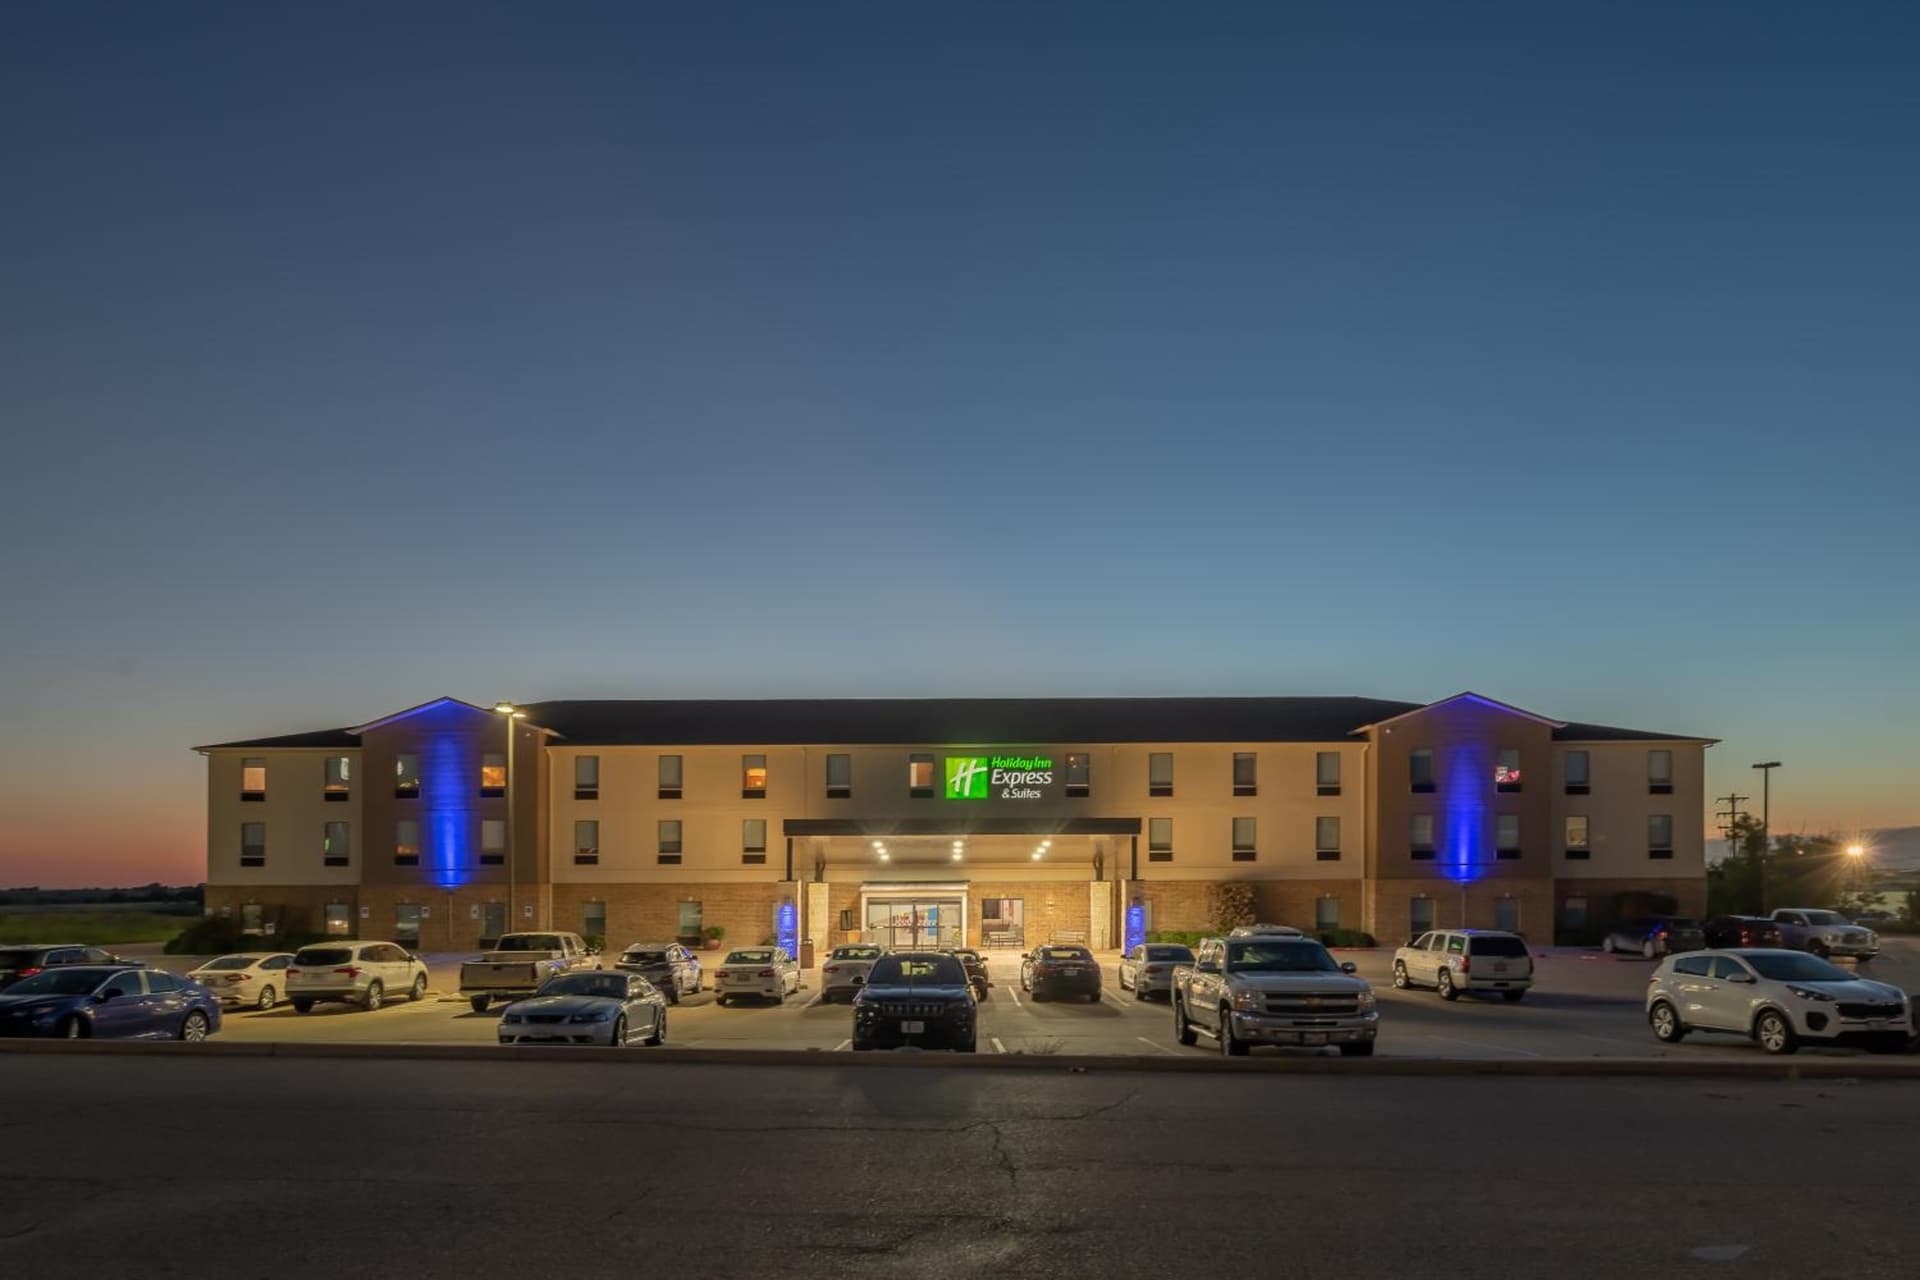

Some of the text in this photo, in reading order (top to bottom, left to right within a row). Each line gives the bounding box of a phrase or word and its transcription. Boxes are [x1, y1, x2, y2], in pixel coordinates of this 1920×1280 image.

[991, 756, 1053, 770] Holiday Inn
[991, 769, 1054, 788] Express
[1001, 788, 1042, 799] & Suites
